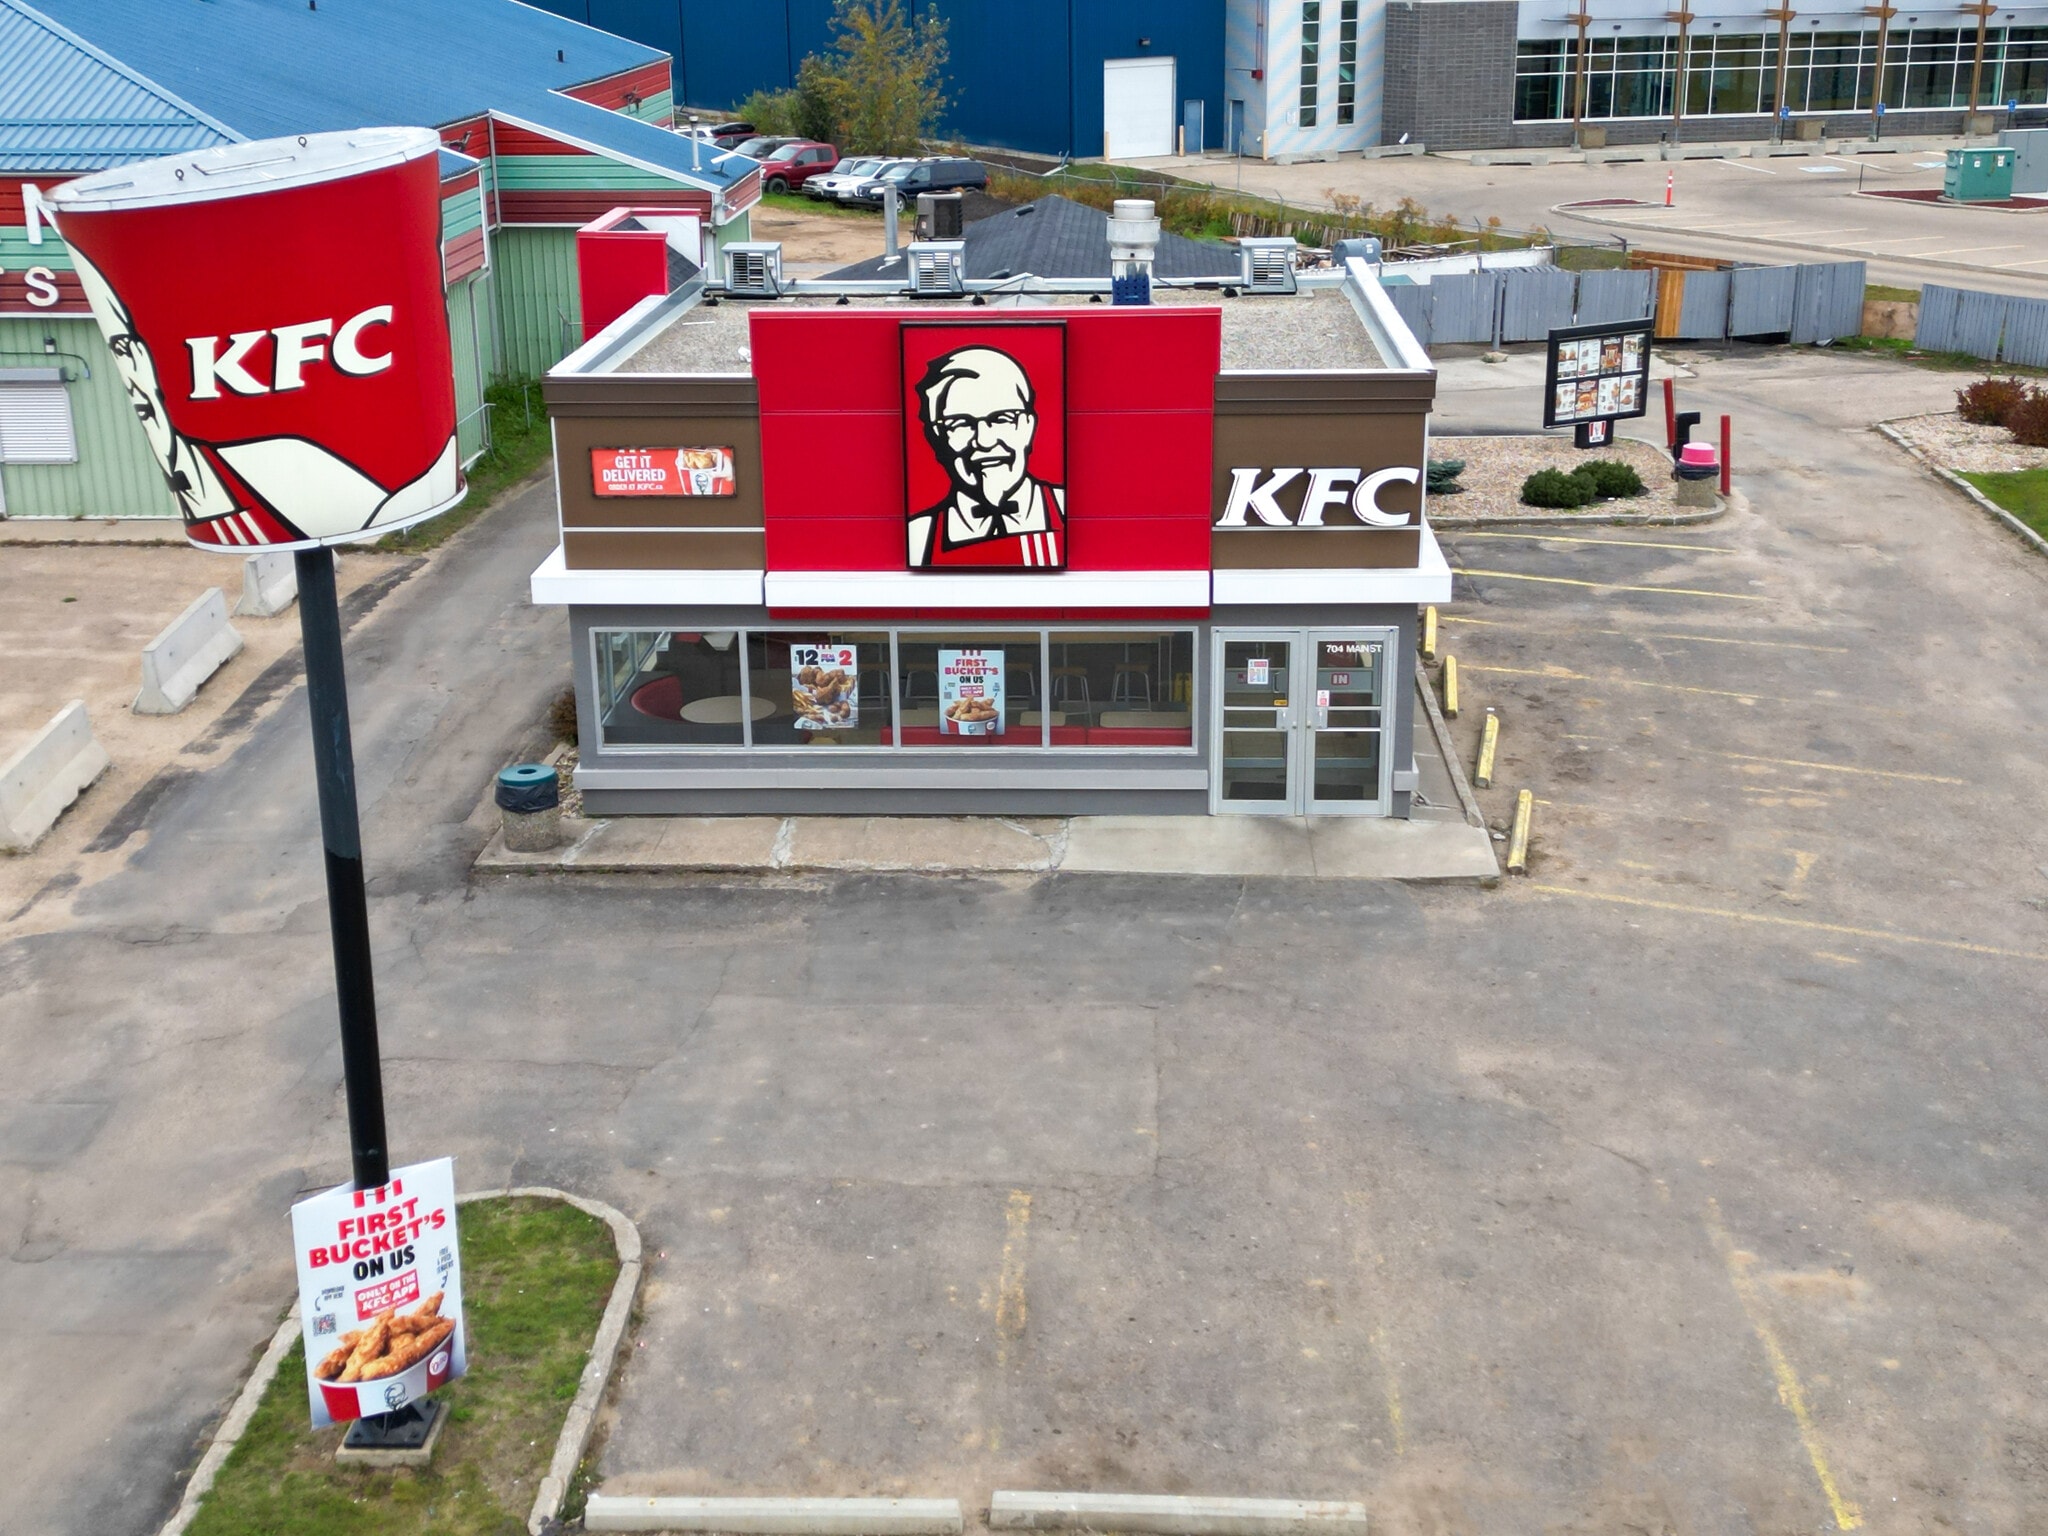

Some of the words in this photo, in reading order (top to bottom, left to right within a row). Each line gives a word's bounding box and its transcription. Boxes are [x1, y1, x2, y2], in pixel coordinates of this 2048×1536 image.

[185, 304, 394, 400] KFC
[615, 455, 637, 468] GET
[640, 455, 652, 468] IT
[602, 469, 666, 482] DELIVERED
[1215, 466, 1420, 527] KFC
[1326, 644, 1344, 653] 704
[796, 649, 819, 666] 12
[838, 649, 853, 666] 2
[955, 659, 988, 667] FIRST
[944, 667, 999, 676] BUCKET'S
[959, 676, 972, 684] ON
[973, 676, 984, 684] US
[1333, 674, 1348, 685] IN
[338, 1197, 418, 1240] FIRST
[309, 1208, 446, 1269] BUCKET'S
[353, 1257, 384, 1281] ON
[390, 1245, 416, 1270] US
[357, 1285, 388, 1302] ONLY
[361, 1294, 391, 1312] KFC
[392, 1282, 417, 1301] APP
